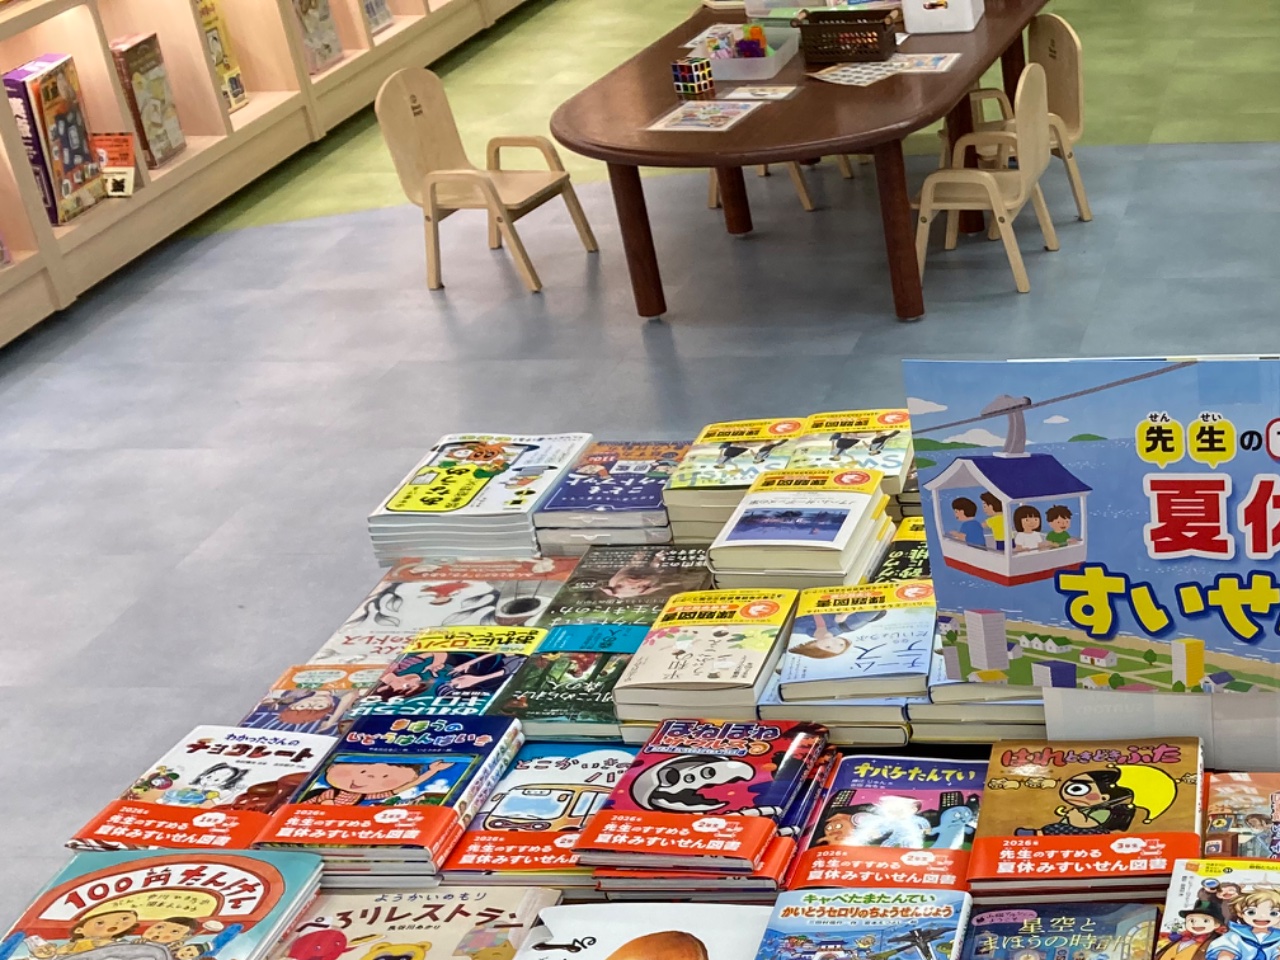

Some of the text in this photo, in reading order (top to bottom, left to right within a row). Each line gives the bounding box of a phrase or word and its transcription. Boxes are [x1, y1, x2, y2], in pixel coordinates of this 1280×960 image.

[1149, 413, 1171, 422] せん
[1200, 413, 1222, 422] せい
[816, 595, 885, 607] 課題図書
[854, 639, 927, 658] テス
[851, 660, 925, 671] チーム
[358, 694, 486, 706] ギロンする
[390, 718, 463, 733] まほうの
[663, 720, 780, 740] ほねほね
[224, 733, 300, 747] わかったさんの
[346, 731, 494, 749] じどうはんばいき
[661, 737, 747, 749] ザウルス
[185, 740, 316, 763] チョコレート
[1001, 744, 1181, 768] はれときどきぶた
[852, 763, 976, 781] オバケたんてい
[94, 825, 232, 846] 夏休みすいせん図書
[277, 826, 420, 841] 夏休みすいせん図書
[602, 822, 690, 837] 先生のすすめる
[594, 833, 742, 851] 夏休みすいせん図書
[999, 849, 1103, 859] 先生のすすめる
[996, 859, 1168, 874] 夏休みすいせん図書
[806, 869, 957, 885] 夏休みすいせん図書
[62, 864, 258, 916] 100円たんけん
[374, 891, 487, 902] ようかいのもり
[803, 892, 935, 905] キャベたまたんてい
[781, 905, 954, 919] かいとうセロリのちょうせんじょう
[1019, 917, 1096, 933] 星空と
[982, 935, 1125, 950] まほうの時計
